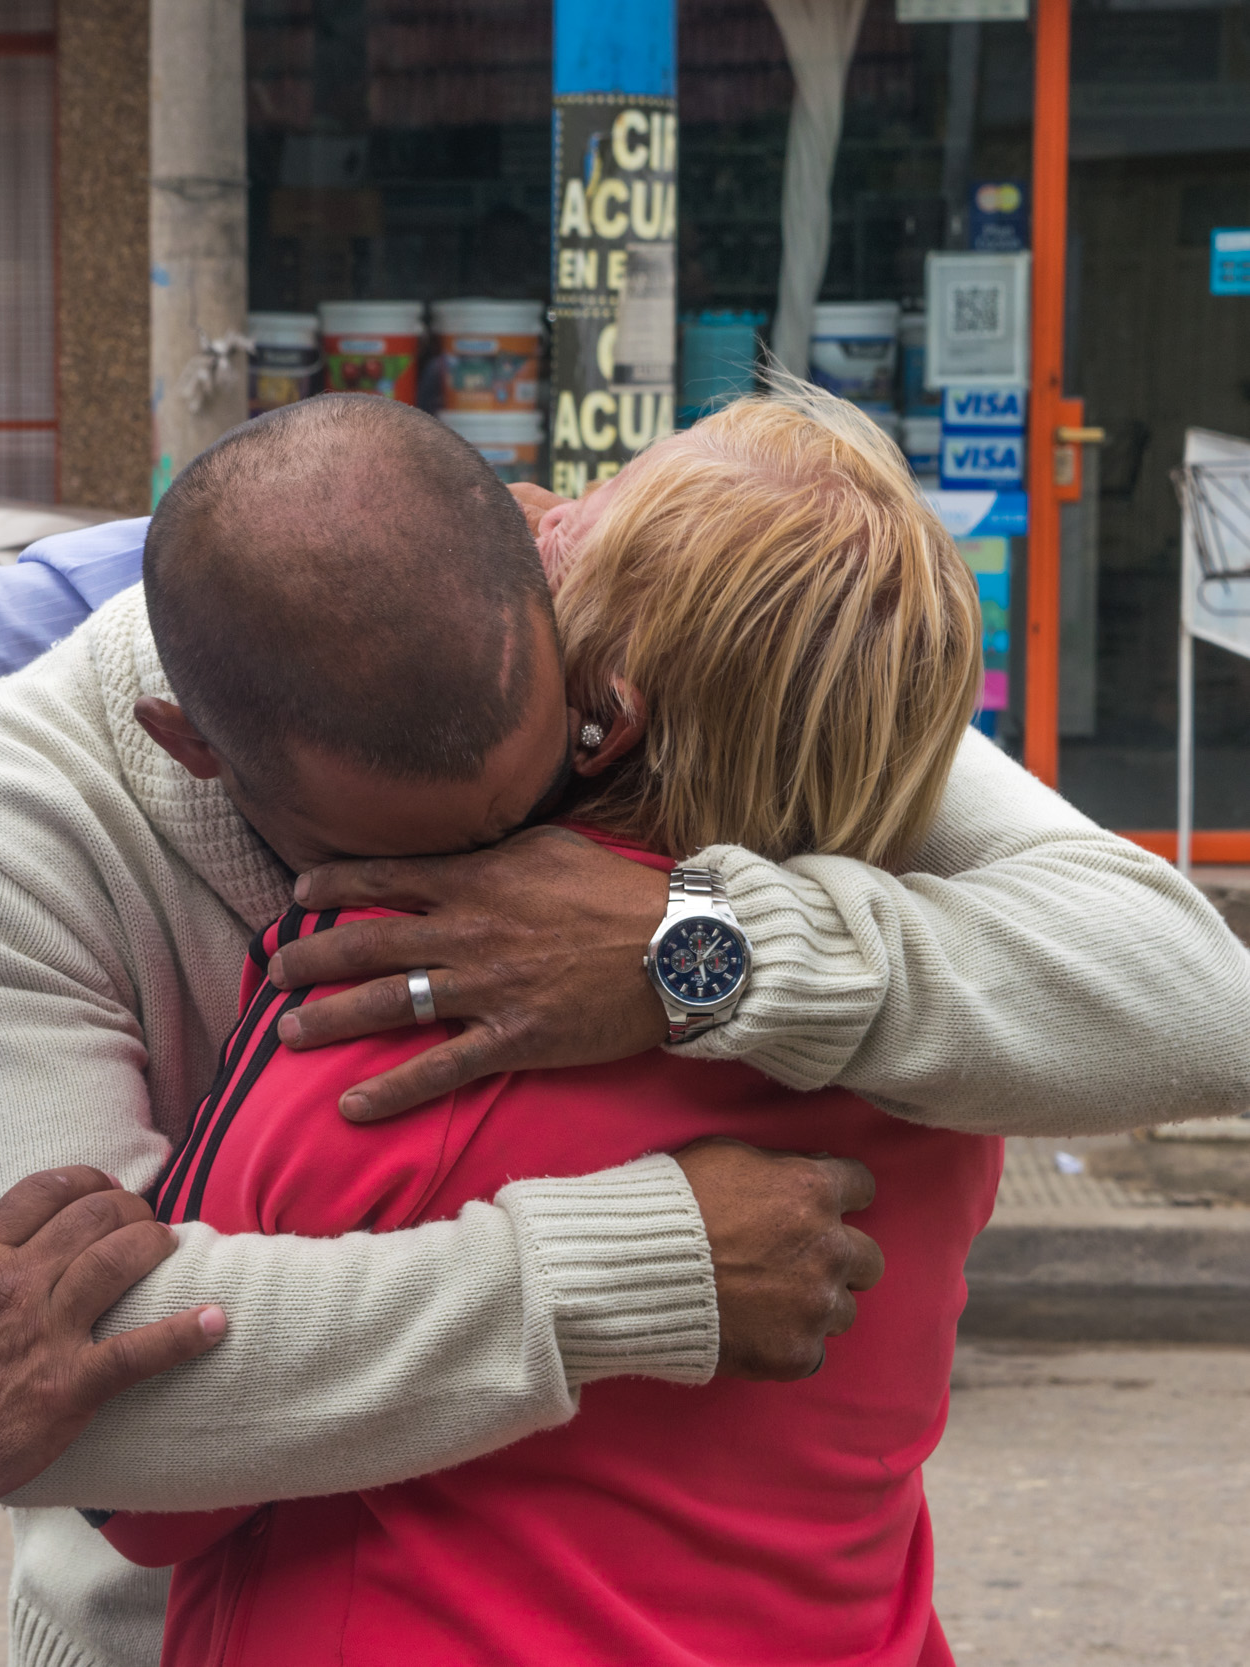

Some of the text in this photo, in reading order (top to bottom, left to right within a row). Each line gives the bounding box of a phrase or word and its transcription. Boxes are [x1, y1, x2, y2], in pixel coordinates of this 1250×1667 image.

[559, 248, 598, 289] EN
[953, 392, 1018, 416] VISA
[951, 446, 1016, 470] VISA
